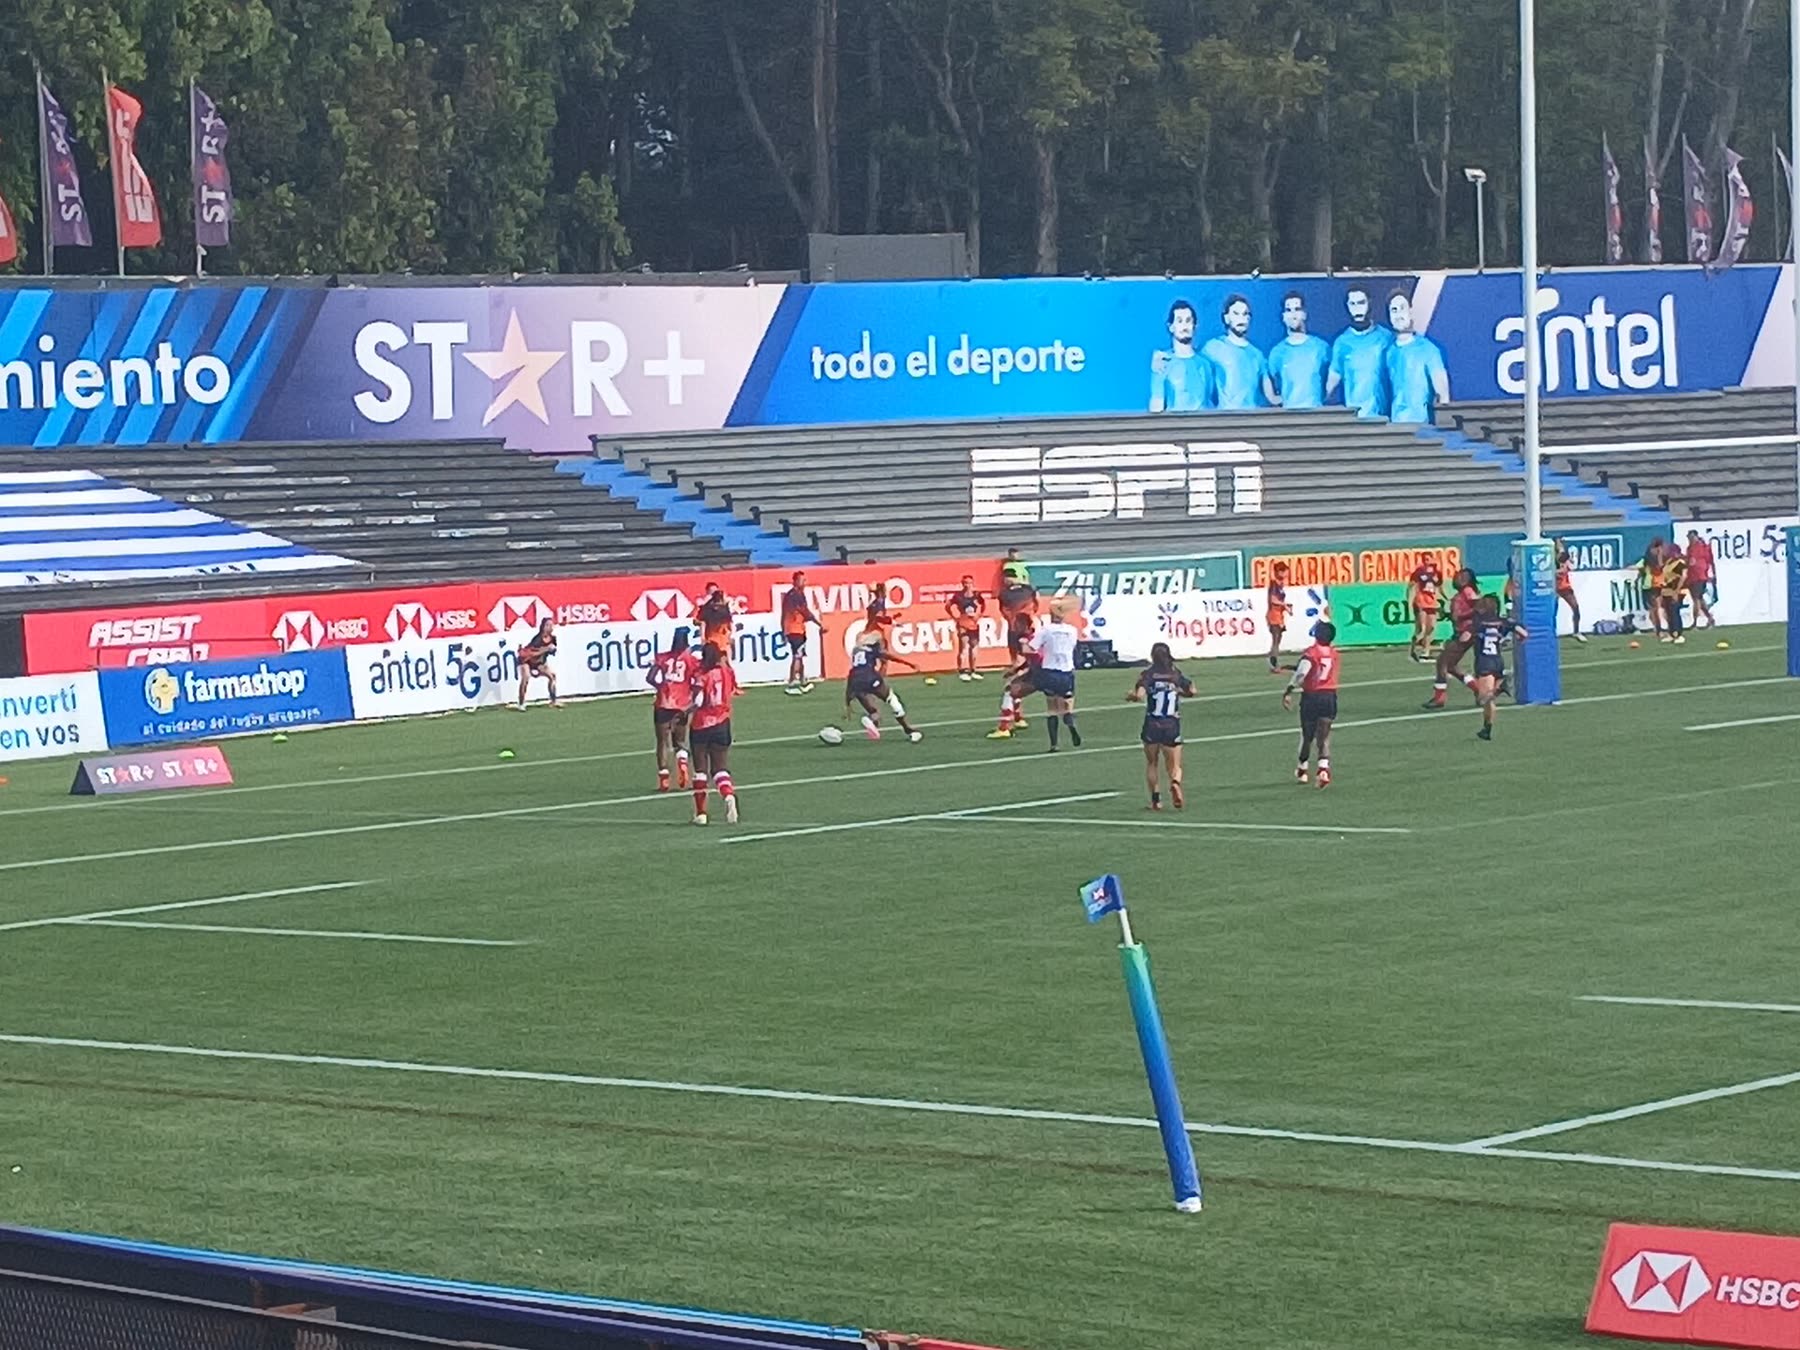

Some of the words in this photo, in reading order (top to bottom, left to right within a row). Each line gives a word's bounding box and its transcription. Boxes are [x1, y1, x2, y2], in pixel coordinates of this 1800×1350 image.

[811, 330, 896, 380] todo
[906, 334, 936, 377] el
[947, 333, 1086, 385] deporte
[970, 441, 1264, 525] ESPN
[1706, 527, 1751, 560] ntel
[1252, 553, 1354, 587] CARIAS
[327, 617, 369, 640] HSBC
[436, 609, 477, 631] HSBC
[556, 603, 610, 622] HSBC
[88, 615, 202, 648] ASSIST
[586, 629, 659, 672] antel
[184, 663, 306, 699] farmashop
[369, 649, 438, 694] antel
[446, 643, 481, 699] 5G
[1318, 657, 1332, 681] 7
[0, 684, 77, 717] nvertí
[1152, 690, 1177, 717] 11
[0, 729, 30, 749] en
[36, 723, 80, 746] vos
[1716, 1275, 1800, 1309] HSBC
